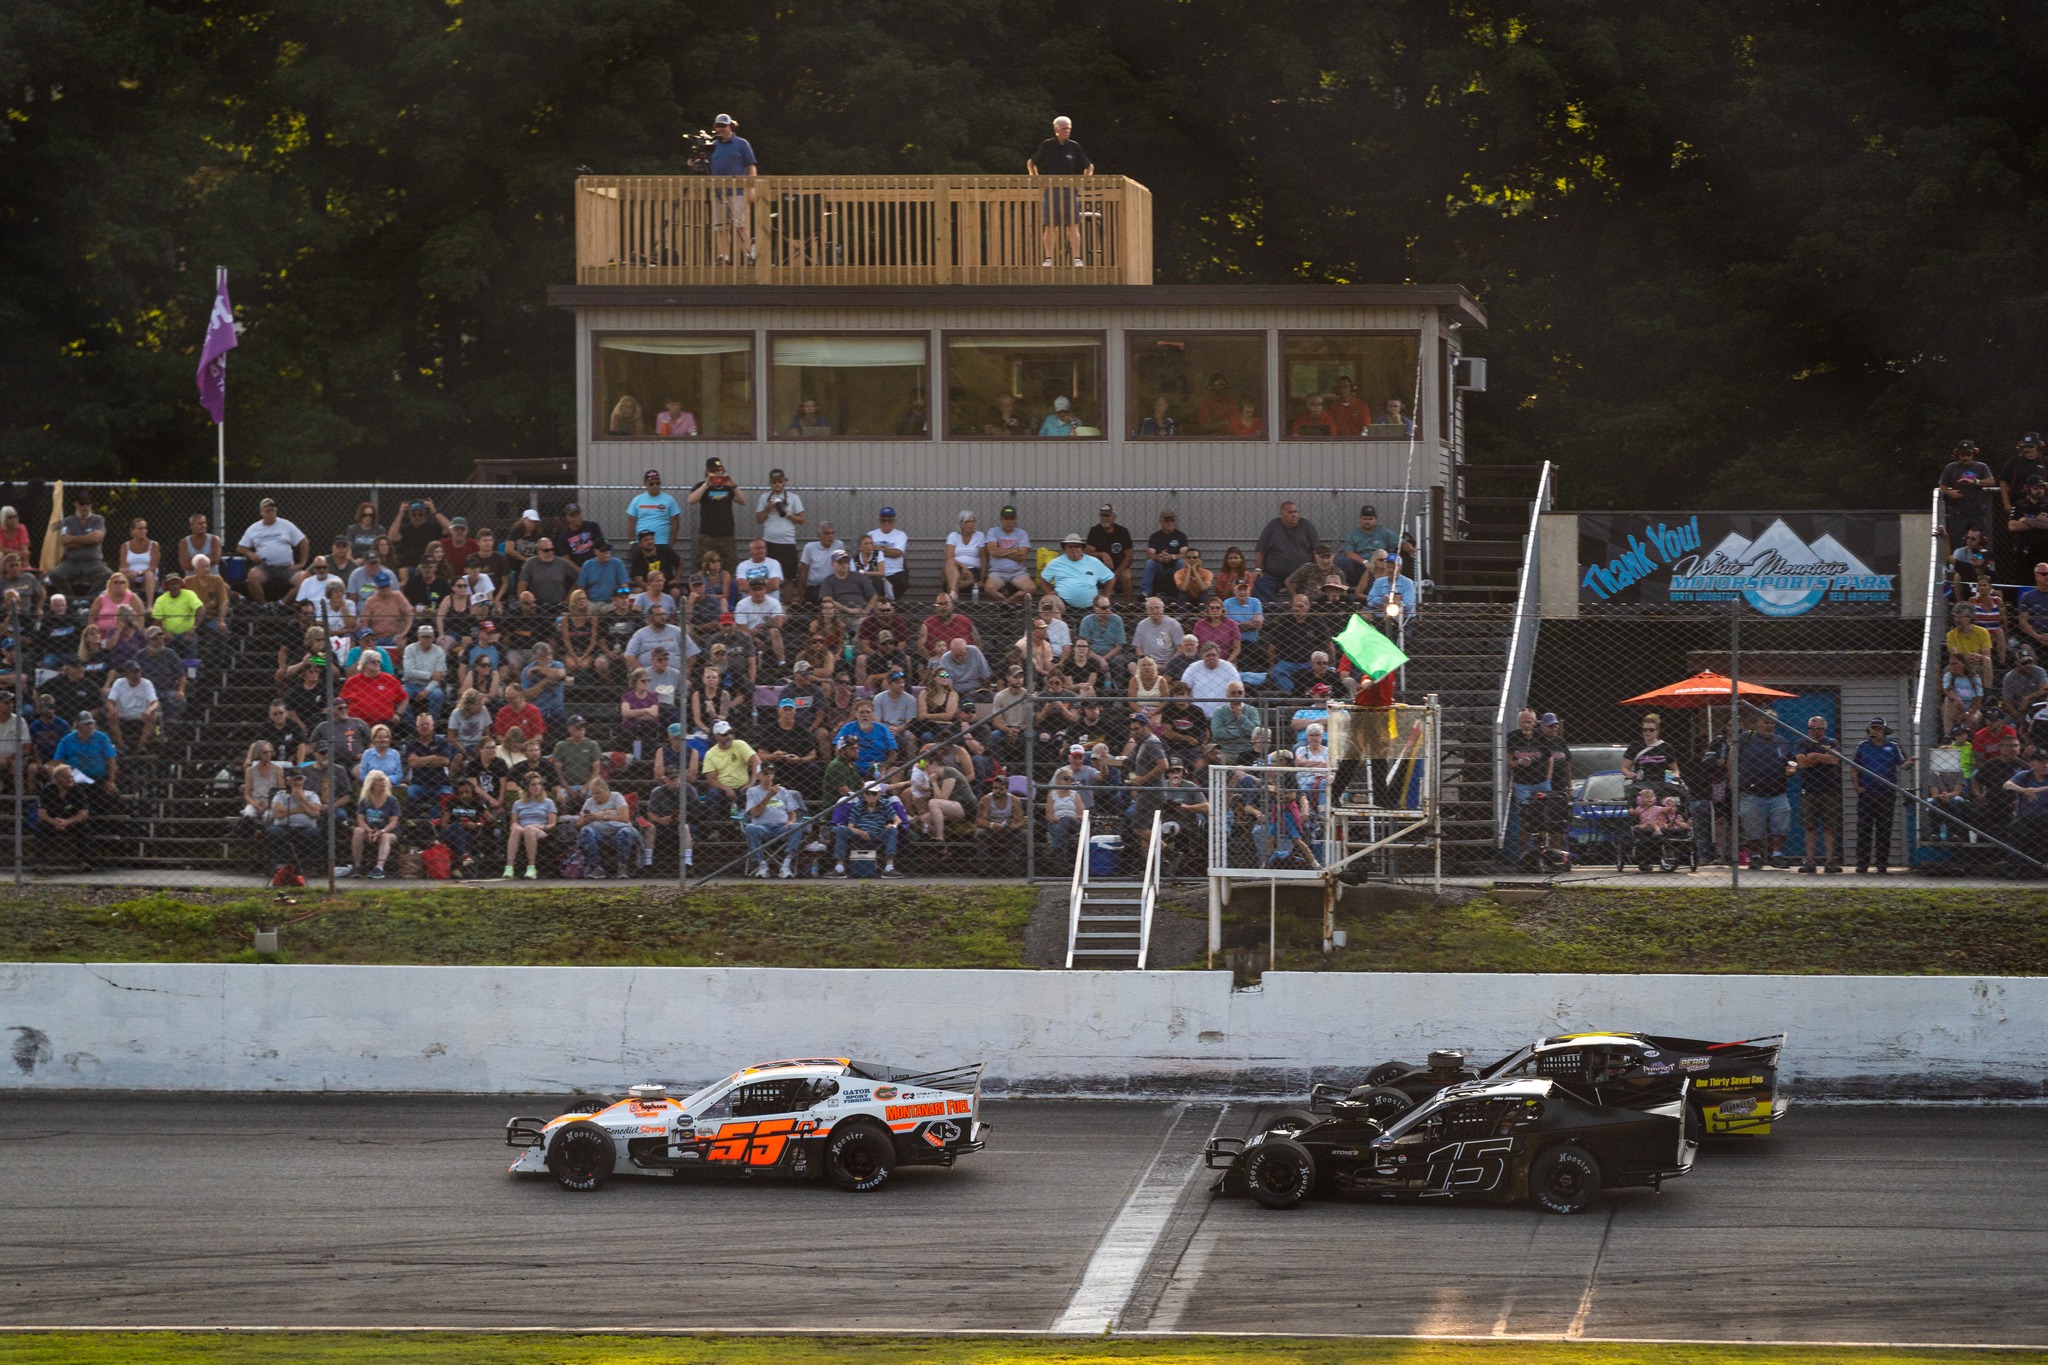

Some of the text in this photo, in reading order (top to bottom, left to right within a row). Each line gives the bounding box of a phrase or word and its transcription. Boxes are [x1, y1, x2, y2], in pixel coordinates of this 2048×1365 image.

[1582, 515, 1701, 599] Thank You!
[1672, 548, 1849, 579] White Mountain
[1669, 575, 1895, 591] MOTORSPORTS PARK
[843, 1088, 871, 1096] GATOR
[1696, 1075, 1764, 1087] One Thirty Seven Gas
[566, 1131, 602, 1144] Hoosier
[640, 1125, 667, 1137] Strong
[707, 1117, 798, 1166] 55
[832, 1132, 864, 1156] Hoosier
[1249, 1153, 1266, 1189] Hoosier
[1419, 1137, 1514, 1197] 15
[1559, 1152, 1592, 1175] Hoosier
[856, 1167, 888, 1190] Hoosier
